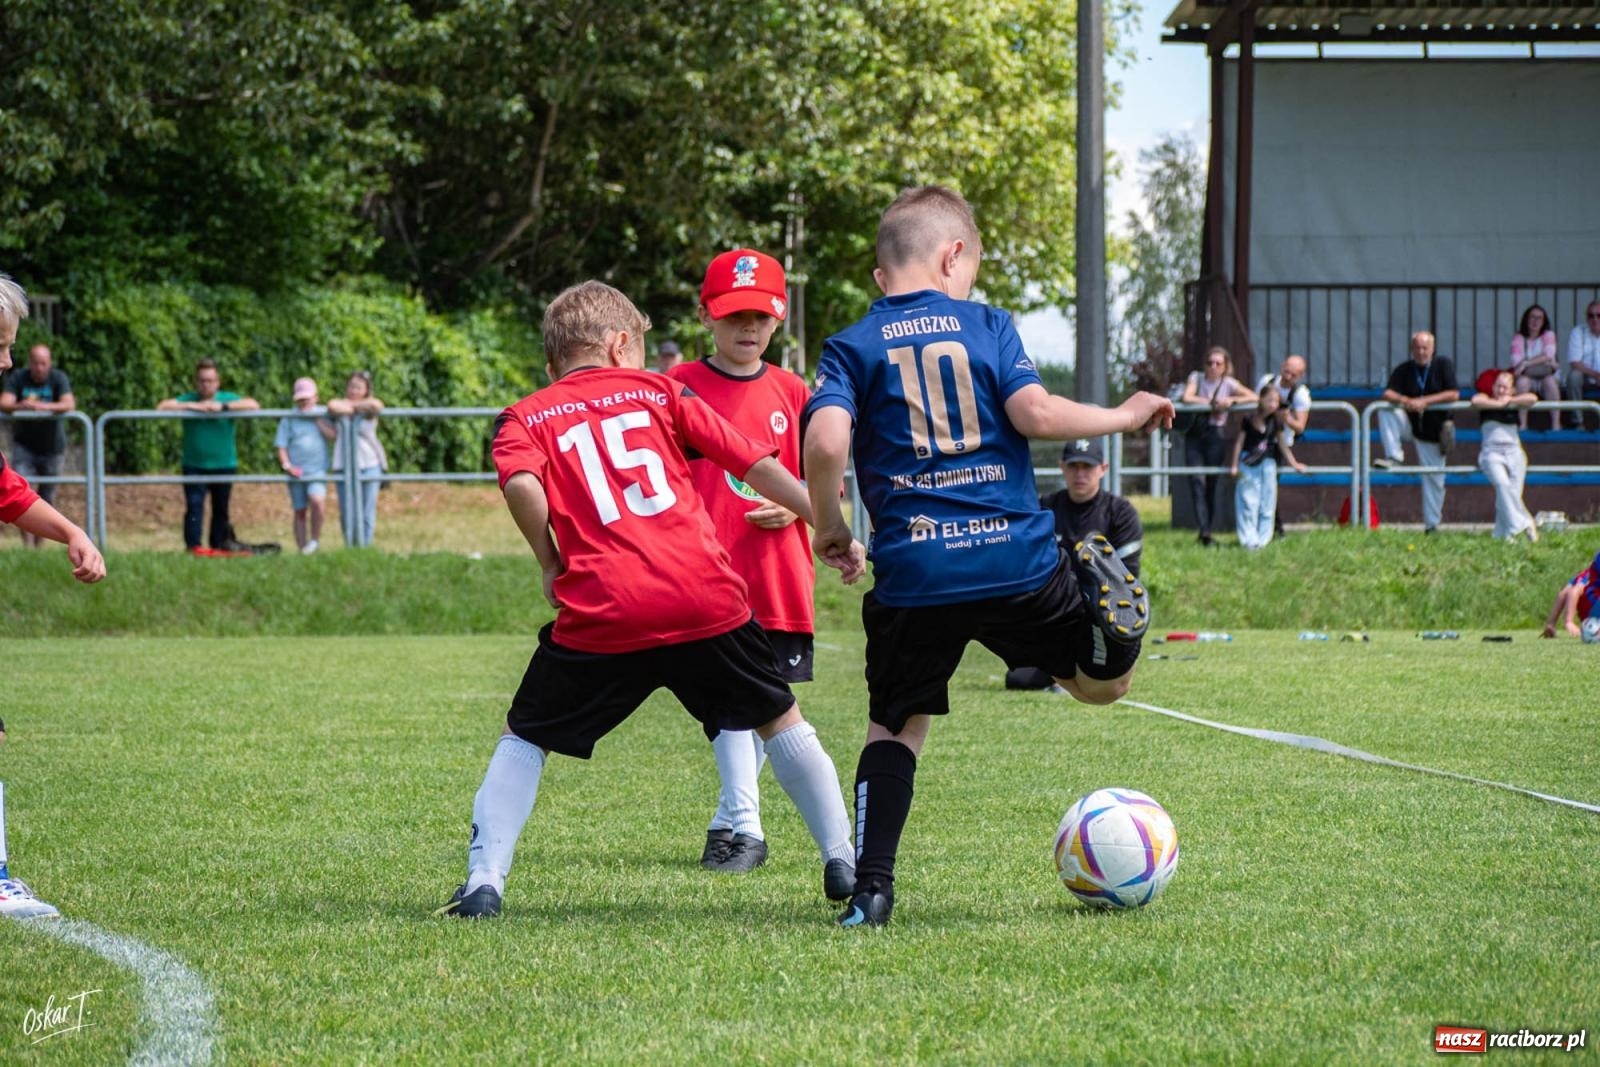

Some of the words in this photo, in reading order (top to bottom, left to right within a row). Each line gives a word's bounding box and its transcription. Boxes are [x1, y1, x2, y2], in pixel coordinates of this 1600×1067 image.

[881, 315, 961, 340] SOBECZKO
[526, 402, 588, 428] JUNIOR
[591, 389, 668, 408] TRENING
[886, 341, 982, 460] 10
[556, 410, 677, 526] 15
[934, 467, 973, 489] GMINA
[975, 464, 1007, 483] LYSKI
[941, 517, 1009, 539] EL-BUD
[945, 538, 972, 550] buduj
[975, 537, 981, 546] z
[984, 534, 1011, 545] nami!
